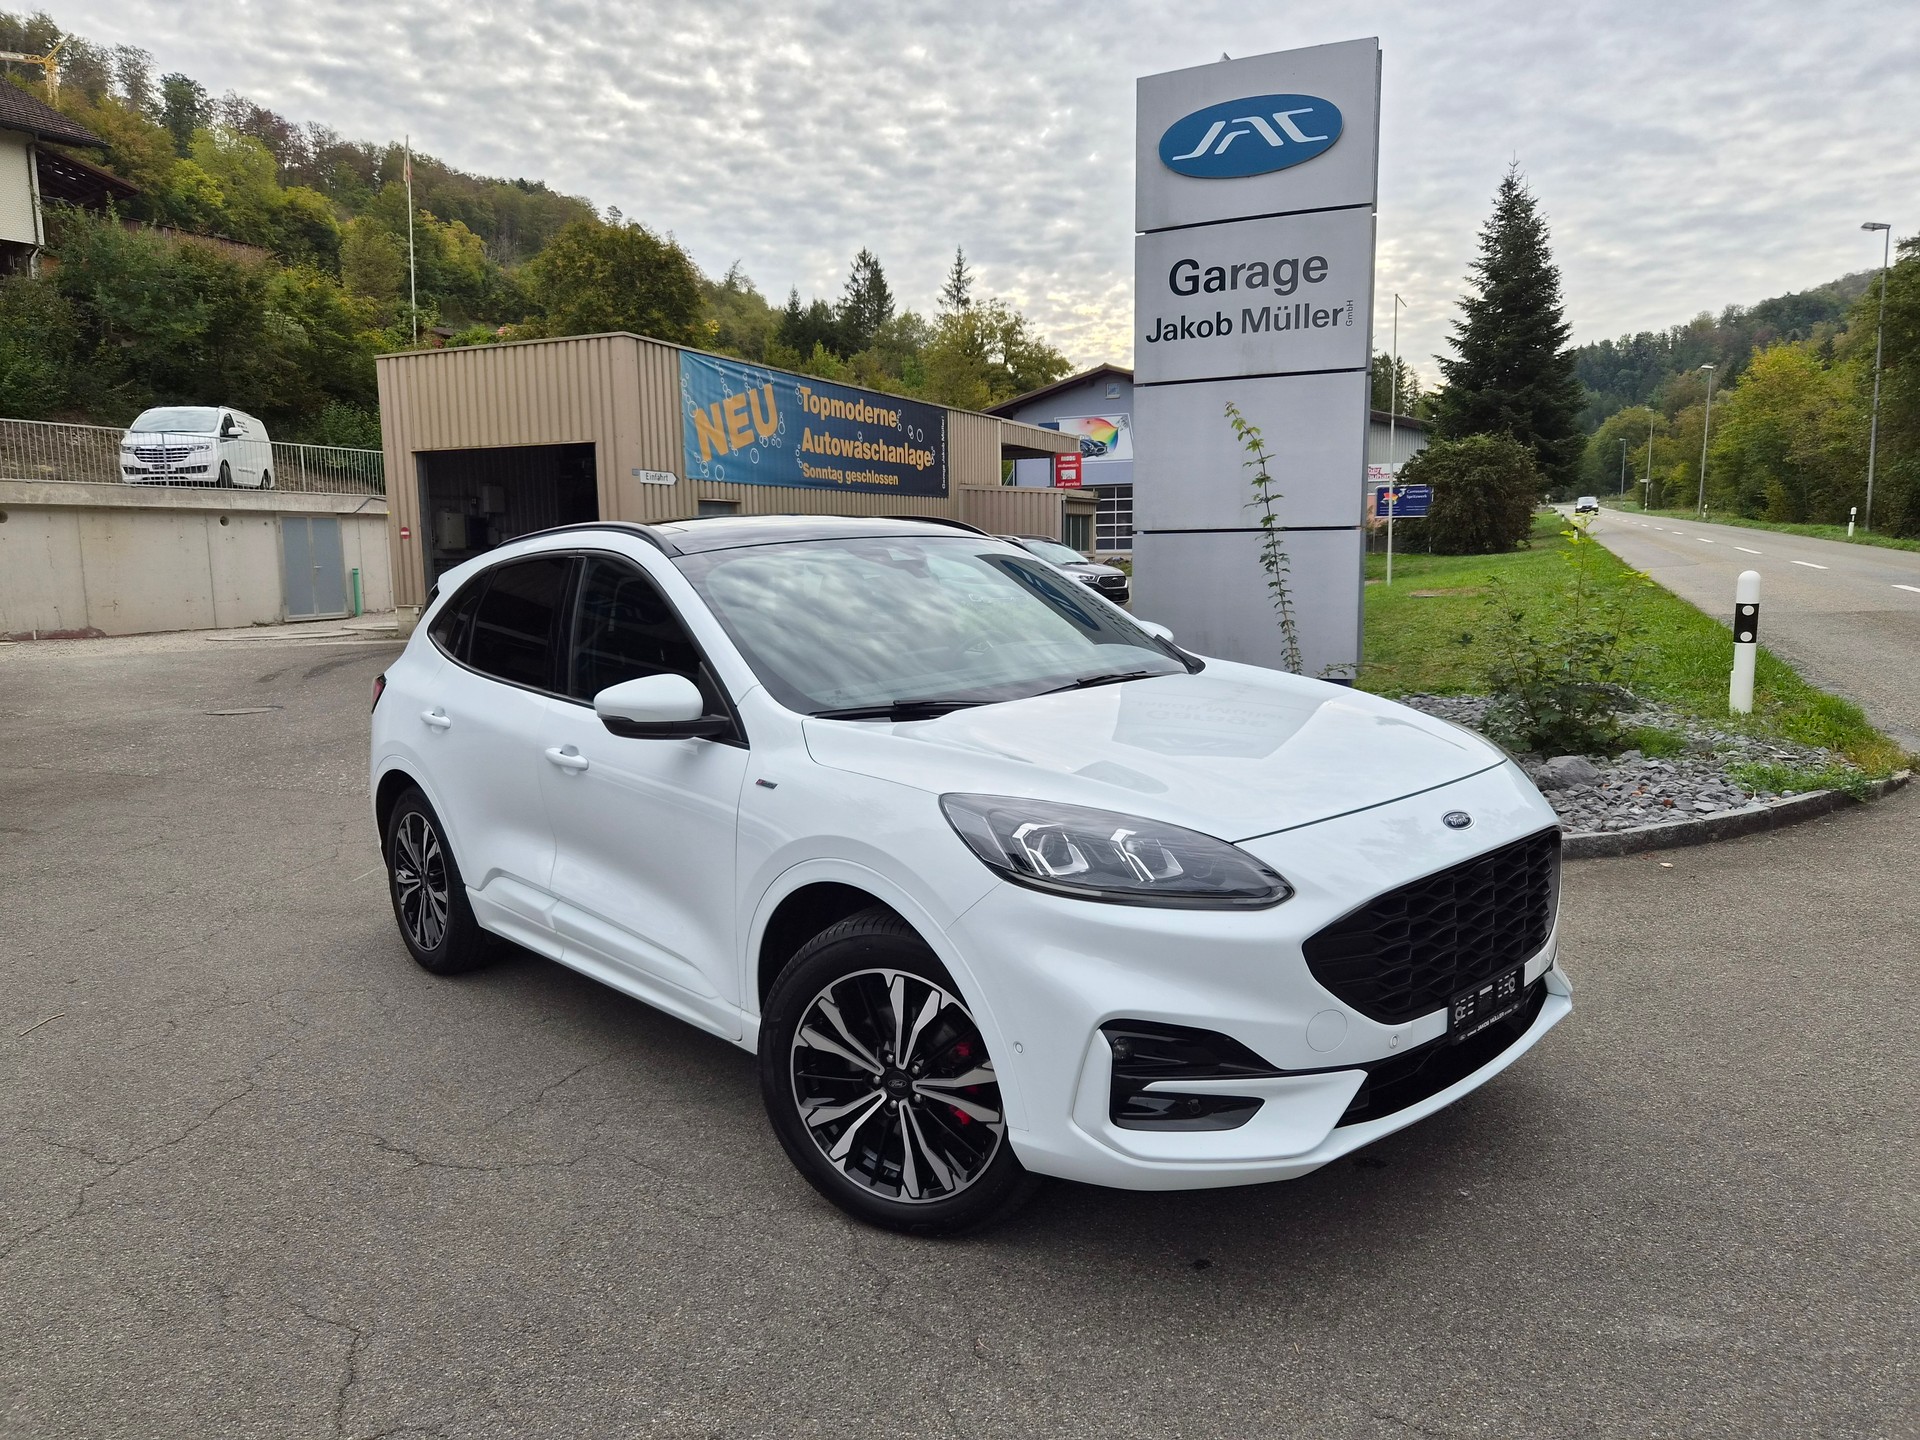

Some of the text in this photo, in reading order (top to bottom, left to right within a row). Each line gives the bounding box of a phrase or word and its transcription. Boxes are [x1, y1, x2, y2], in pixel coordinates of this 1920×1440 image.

[1168, 255, 1328, 297] Garage
[1145, 302, 1345, 344] Jakob Müller
[1345, 299, 1354, 327] GmbH
[693, 383, 778, 462] NEU
[801, 387, 898, 428] Topmoderne
[800, 426, 933, 471] Autowaschanlage
[645, 472, 669, 482] Einfahrt
[801, 462, 899, 487] Sonntag geschlossen
